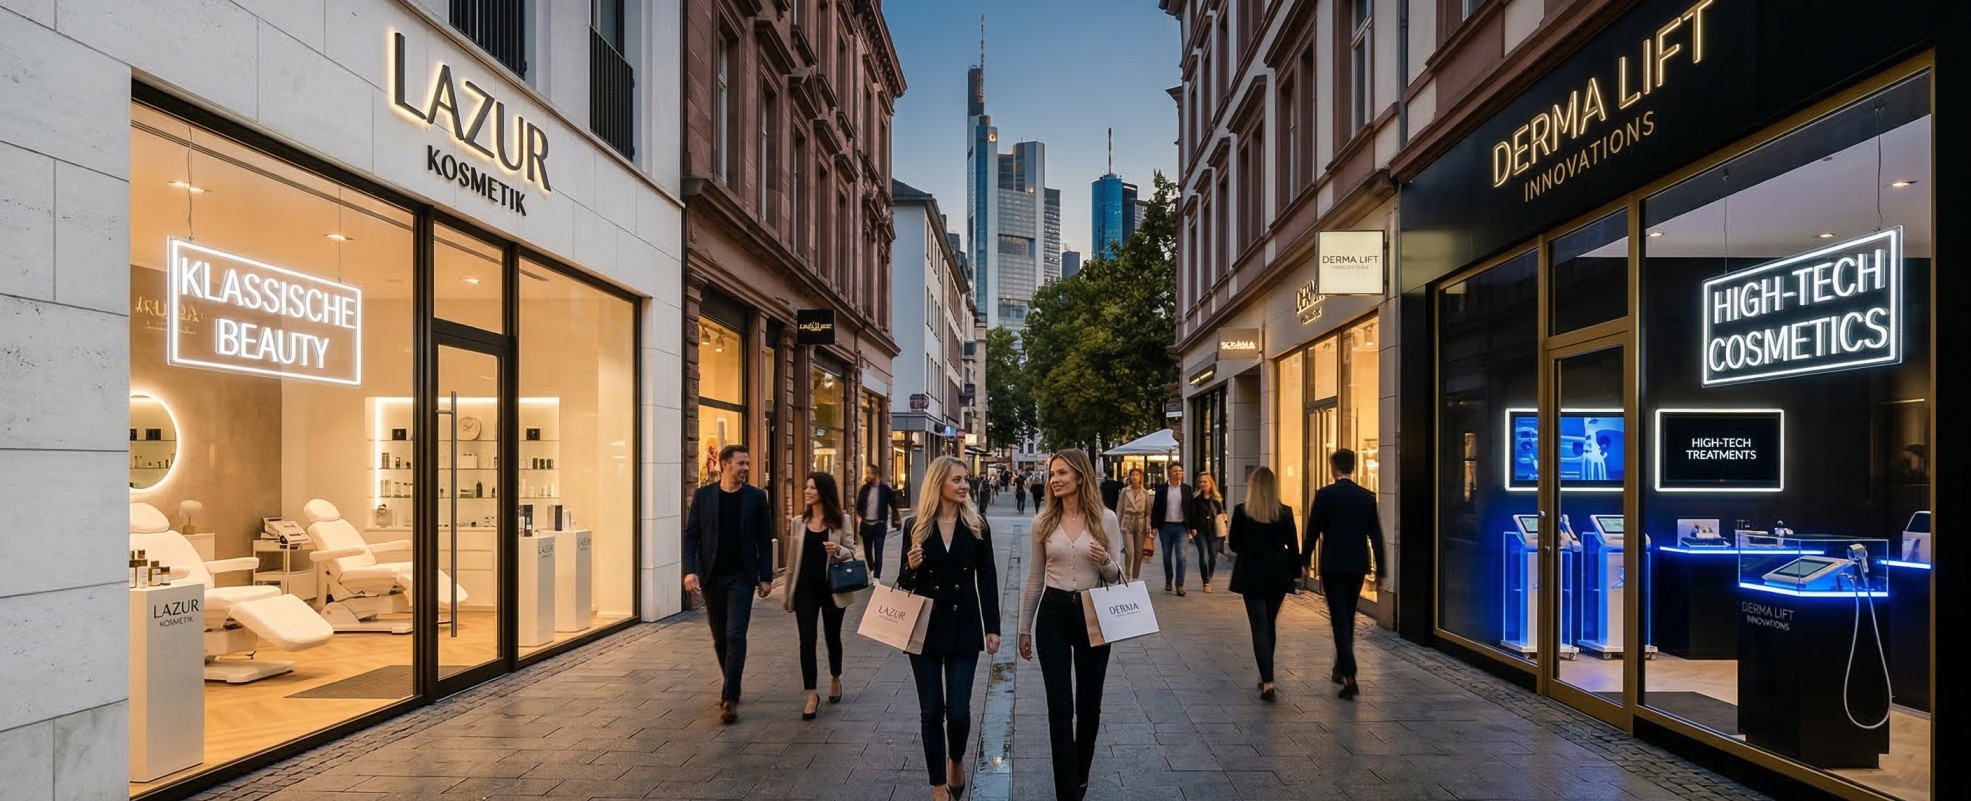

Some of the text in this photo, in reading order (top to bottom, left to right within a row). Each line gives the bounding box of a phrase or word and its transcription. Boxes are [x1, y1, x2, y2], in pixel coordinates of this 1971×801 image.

[394, 32, 552, 192] LAZUR
[1492, 0, 1713, 188] DERMA LIFT
[427, 144, 527, 217] KOSMETIK
[1523, 110, 1656, 203] INNOVATIONS
[1322, 255, 1379, 264] DERMA LIFT
[1713, 248, 1886, 325] HIGH-TECH
[179, 256, 358, 330] KLASSISCHE
[215, 317, 330, 369] BEAUTY
[1708, 307, 1890, 372] COSMETICS
[1685, 449, 1757, 460] TREATMENTS
[1691, 437, 1752, 448] HIGH-TECH
[153, 598, 200, 619] LAZUR
[878, 604, 906, 621] LAZUR
[1741, 601, 1795, 621] DERMA LIFT
